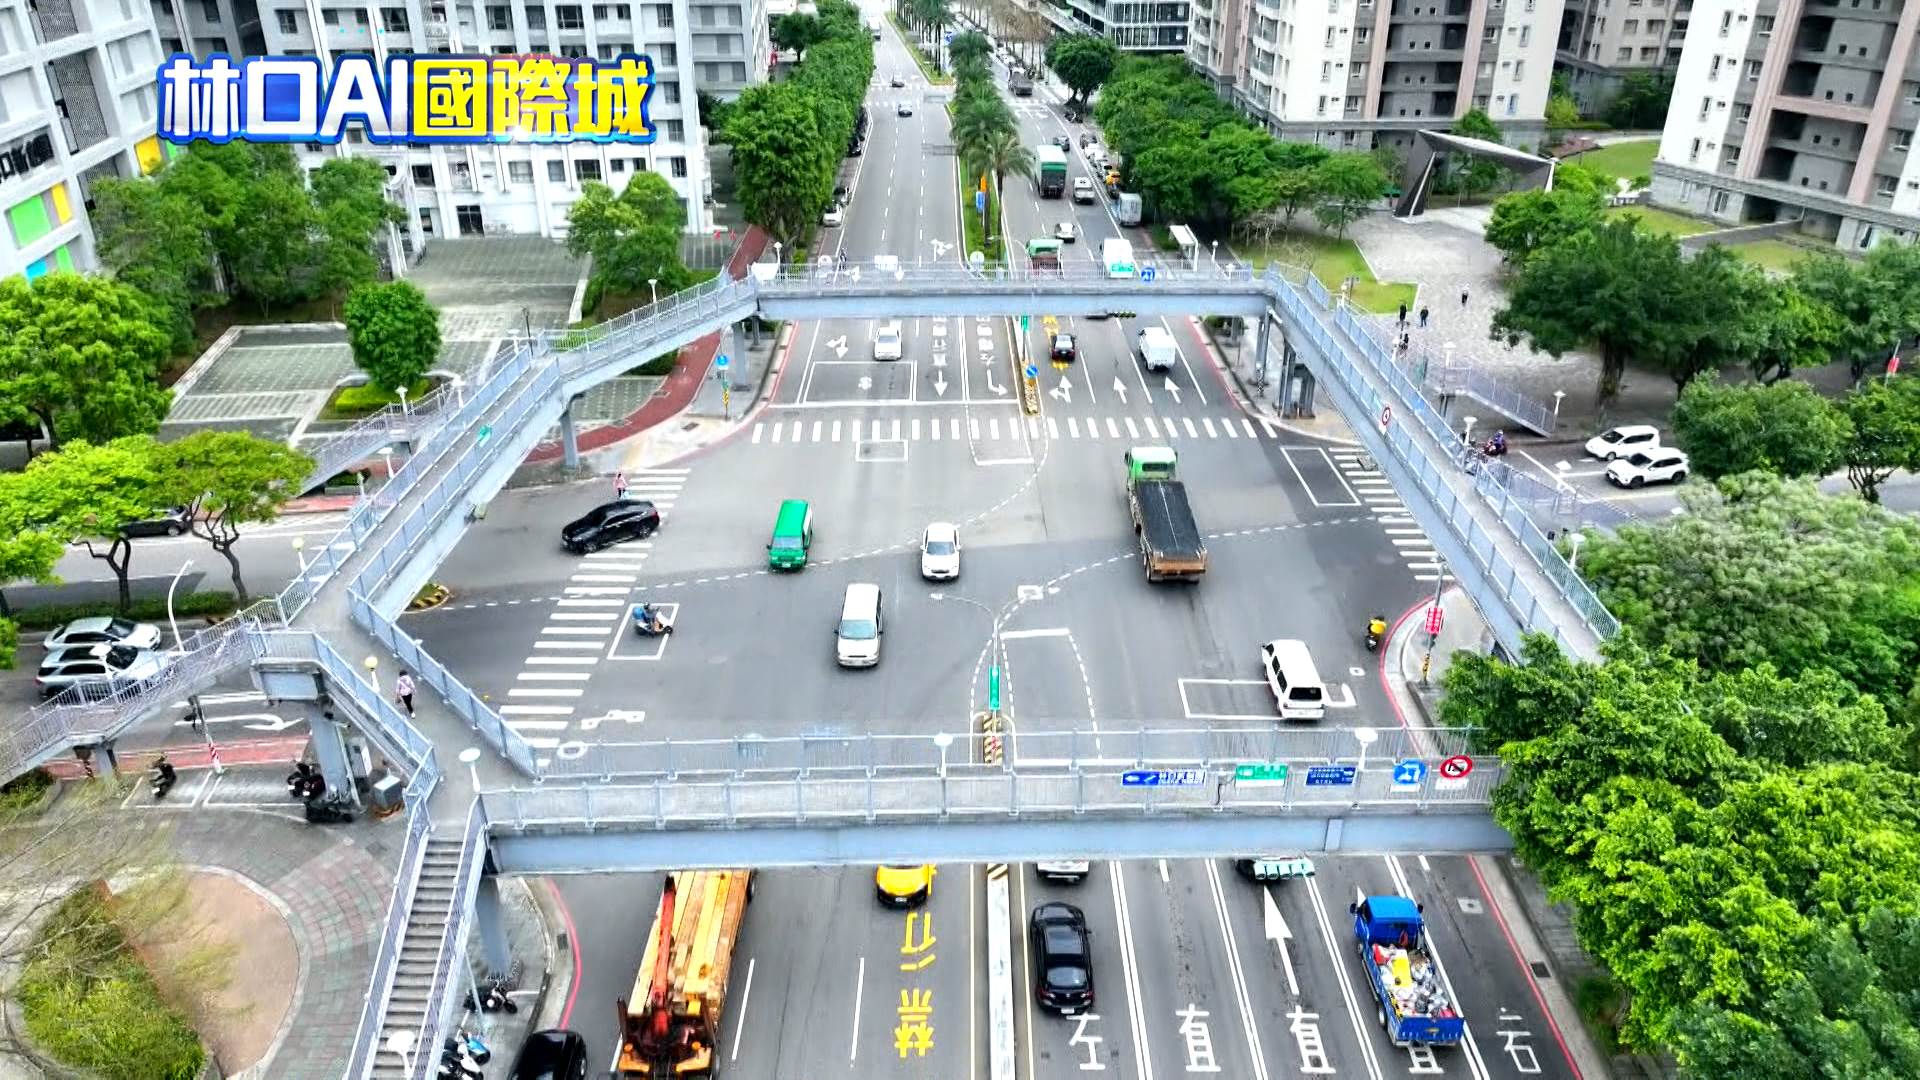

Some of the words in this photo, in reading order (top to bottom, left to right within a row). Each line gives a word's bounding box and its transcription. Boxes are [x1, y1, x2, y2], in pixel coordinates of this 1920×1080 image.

[894, 911, 936, 1058] 禁行
[1067, 1012, 1107, 1072] 左
[1174, 1003, 1223, 1075] 直
[1285, 1004, 1337, 1075] 直
[1496, 1031, 1542, 1074] 右
